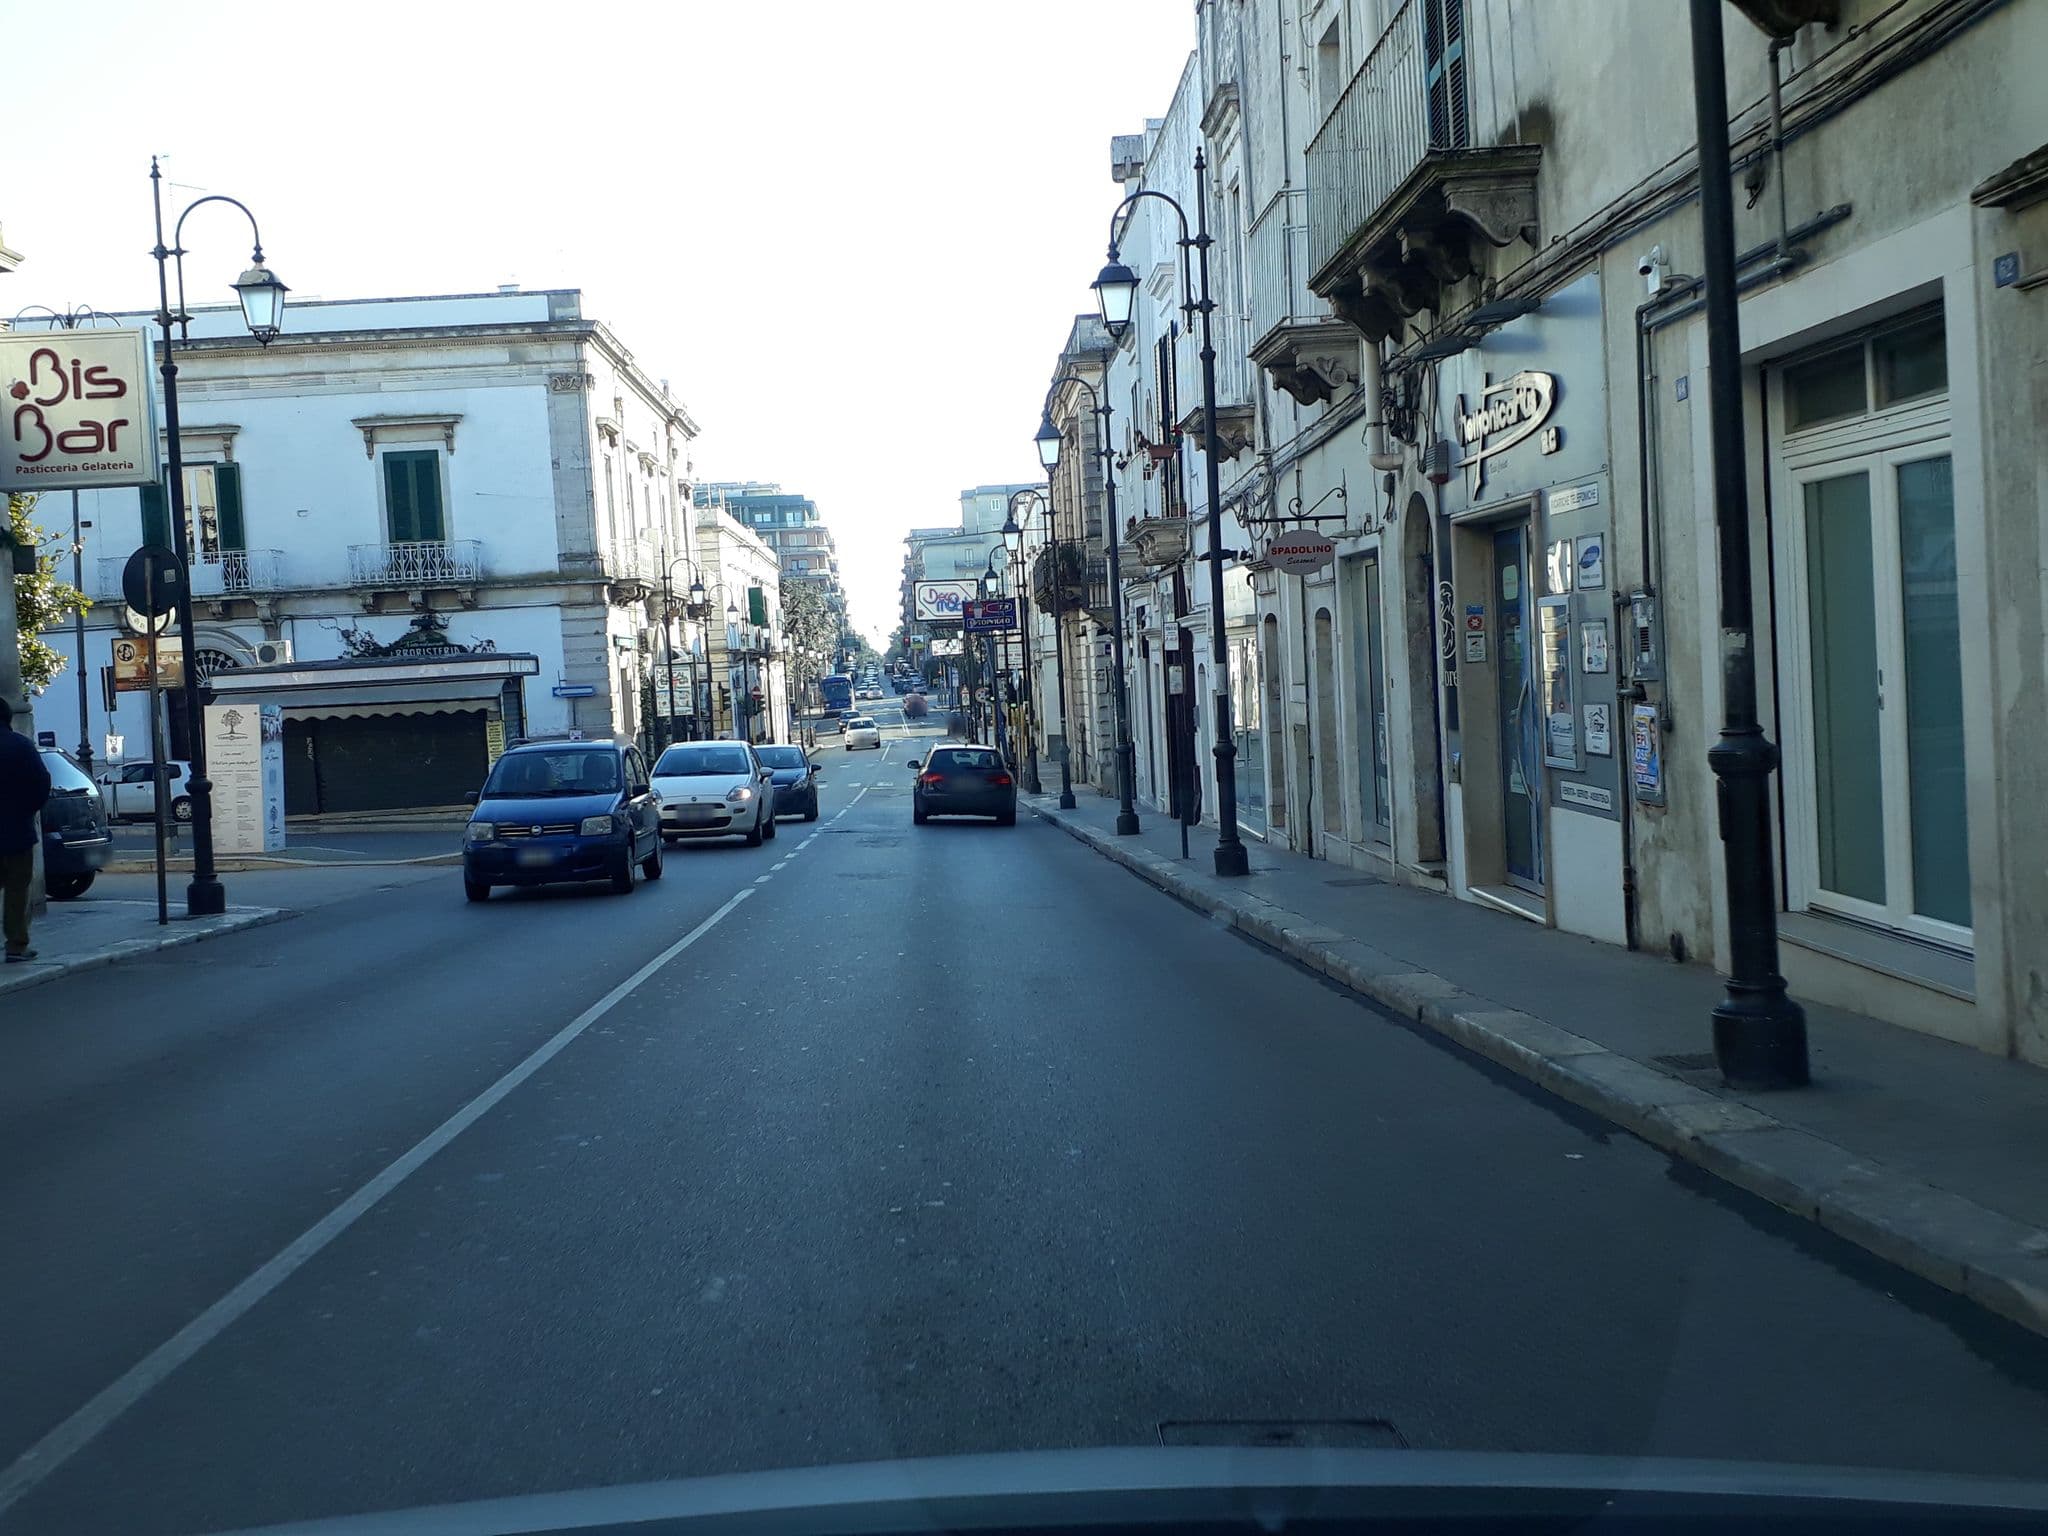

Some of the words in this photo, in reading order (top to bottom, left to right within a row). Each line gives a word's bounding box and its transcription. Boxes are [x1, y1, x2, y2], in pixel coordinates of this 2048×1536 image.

[30, 348, 127, 406] Bis
[14, 404, 129, 462] Bar
[16, 463, 78, 474] Pasticceria
[82, 461, 134, 471] Gelateria
[1271, 544, 1332, 555] SPADOLINO
